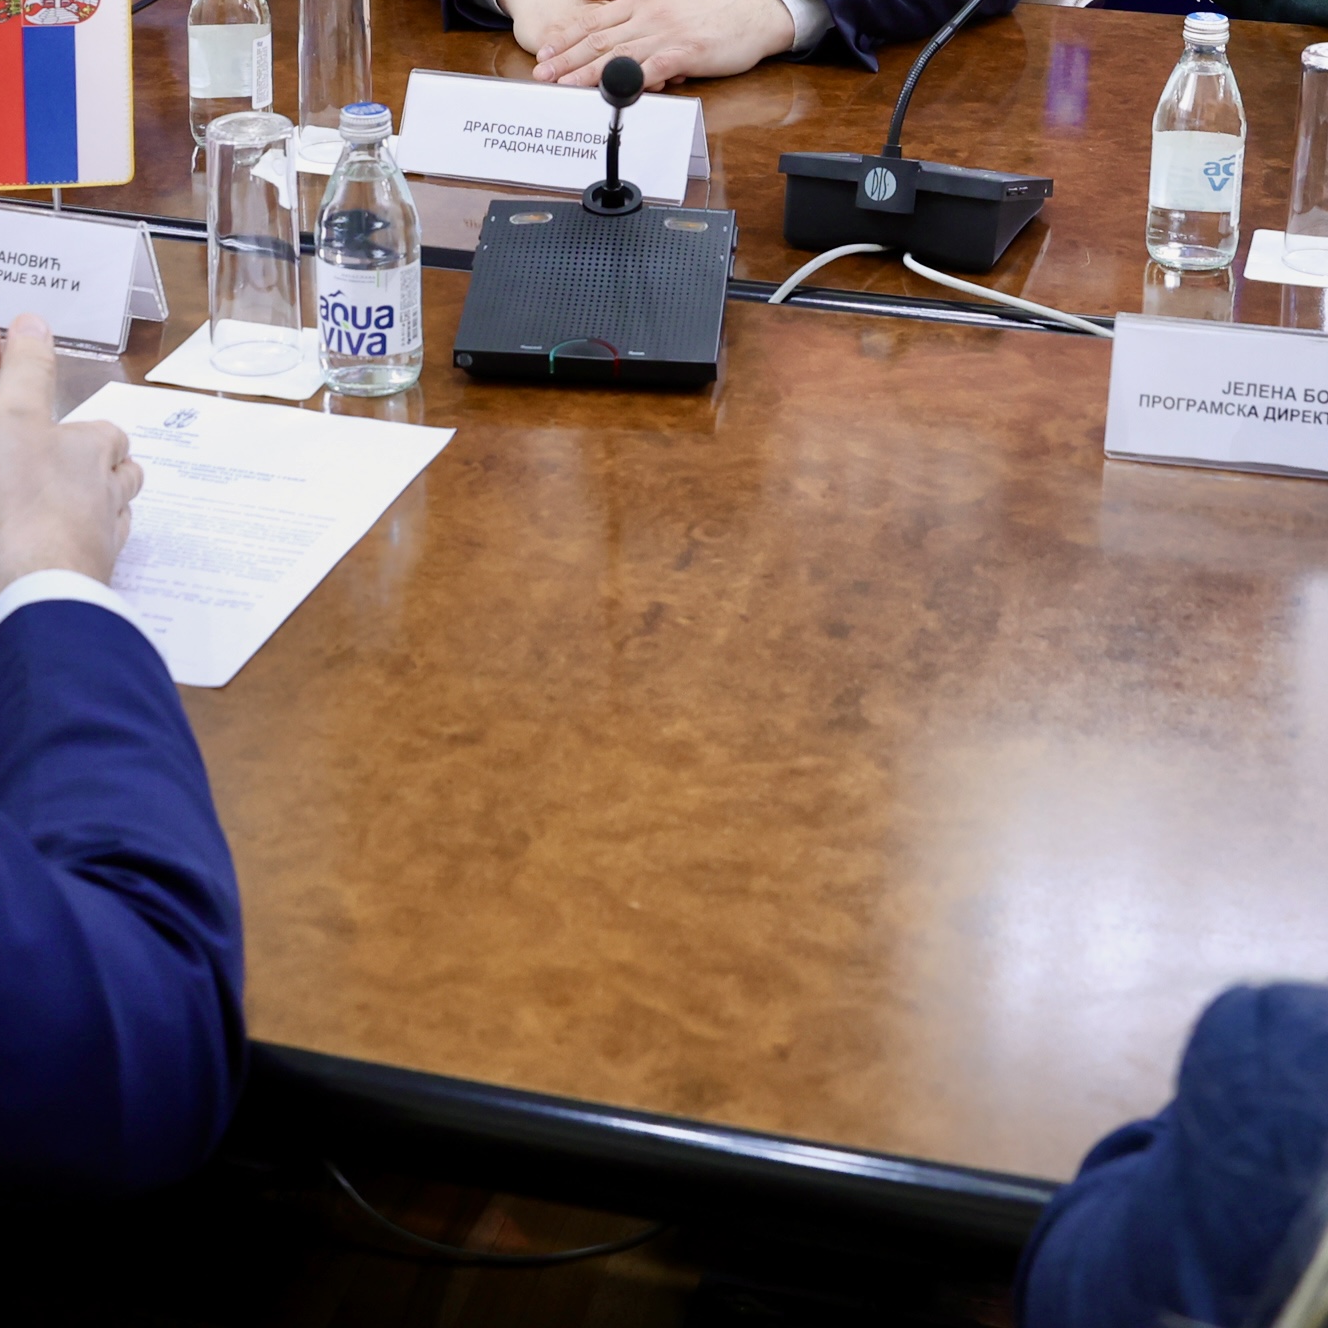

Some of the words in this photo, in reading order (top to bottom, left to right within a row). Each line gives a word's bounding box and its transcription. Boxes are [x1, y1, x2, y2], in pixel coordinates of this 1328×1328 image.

[463, 120, 544, 139] ДРАГОСЛАВ
[546, 129, 614, 147] ПАВЛОВИ
[483, 137, 599, 160] ГРАДОНАЧЕЛНИК
[29, 274, 47, 288] ЗА
[50, 277, 69, 290] ИТ
[71, 280, 81, 292] И
[322, 322, 387, 356] viva
[1222, 380, 1298, 402] ЈЕЛЕНА
[1138, 393, 1260, 419] ПРОГРАМСКА
